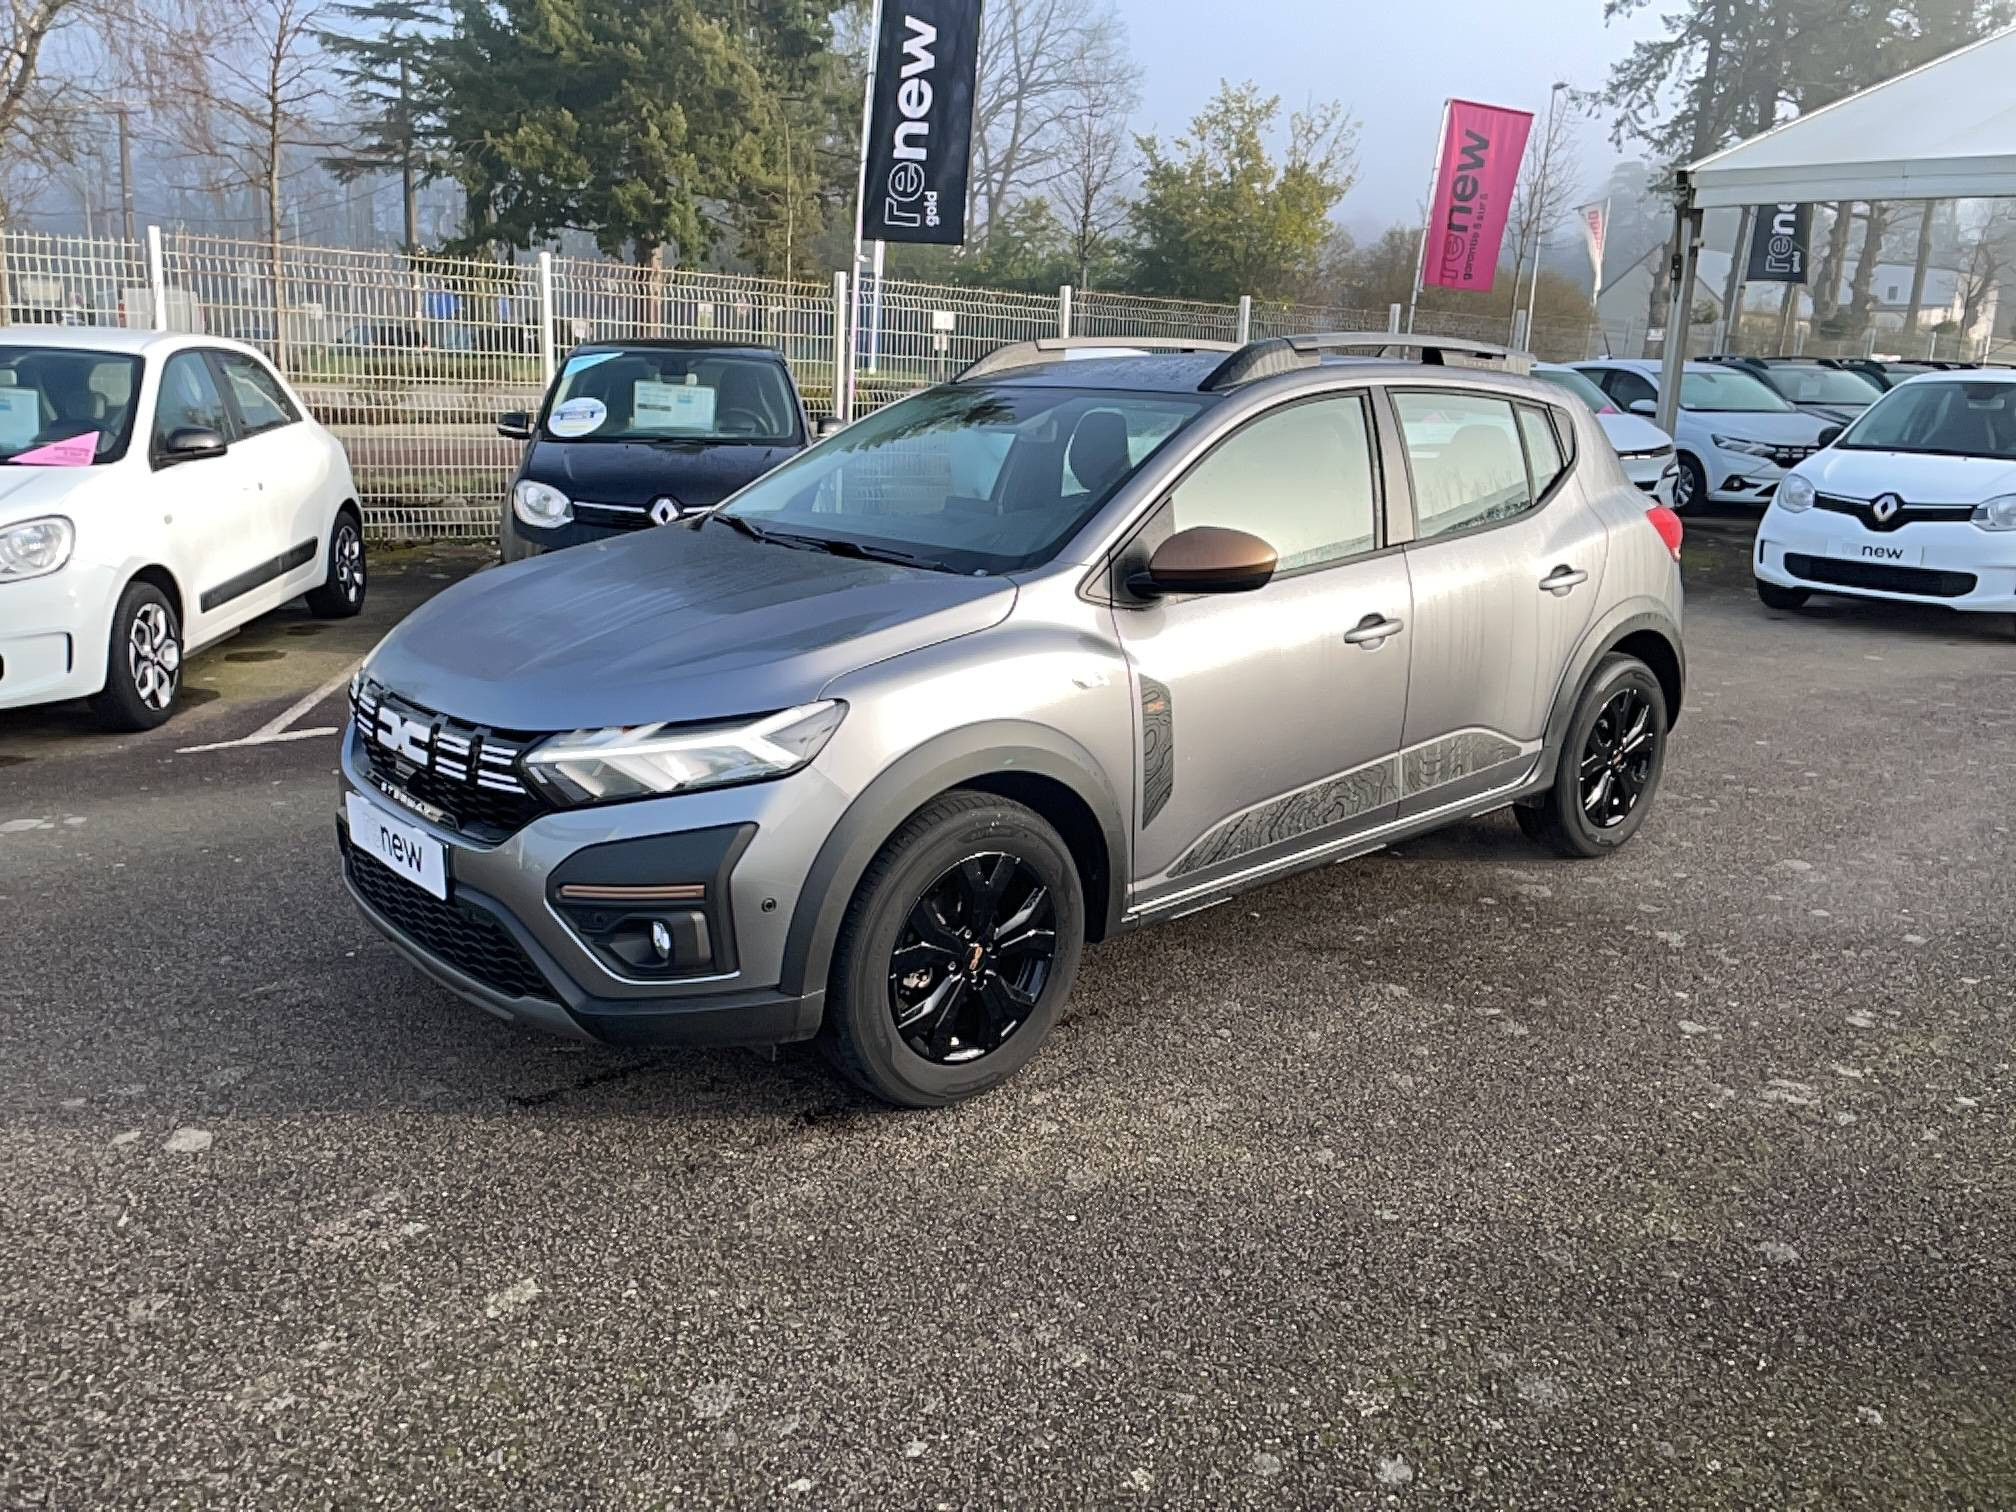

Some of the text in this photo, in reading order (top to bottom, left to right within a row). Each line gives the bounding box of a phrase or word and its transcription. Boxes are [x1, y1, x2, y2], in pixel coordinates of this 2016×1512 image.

[884, 15, 937, 228] renew
[924, 190, 942, 228] gold
[1441, 128, 1490, 280] renew
